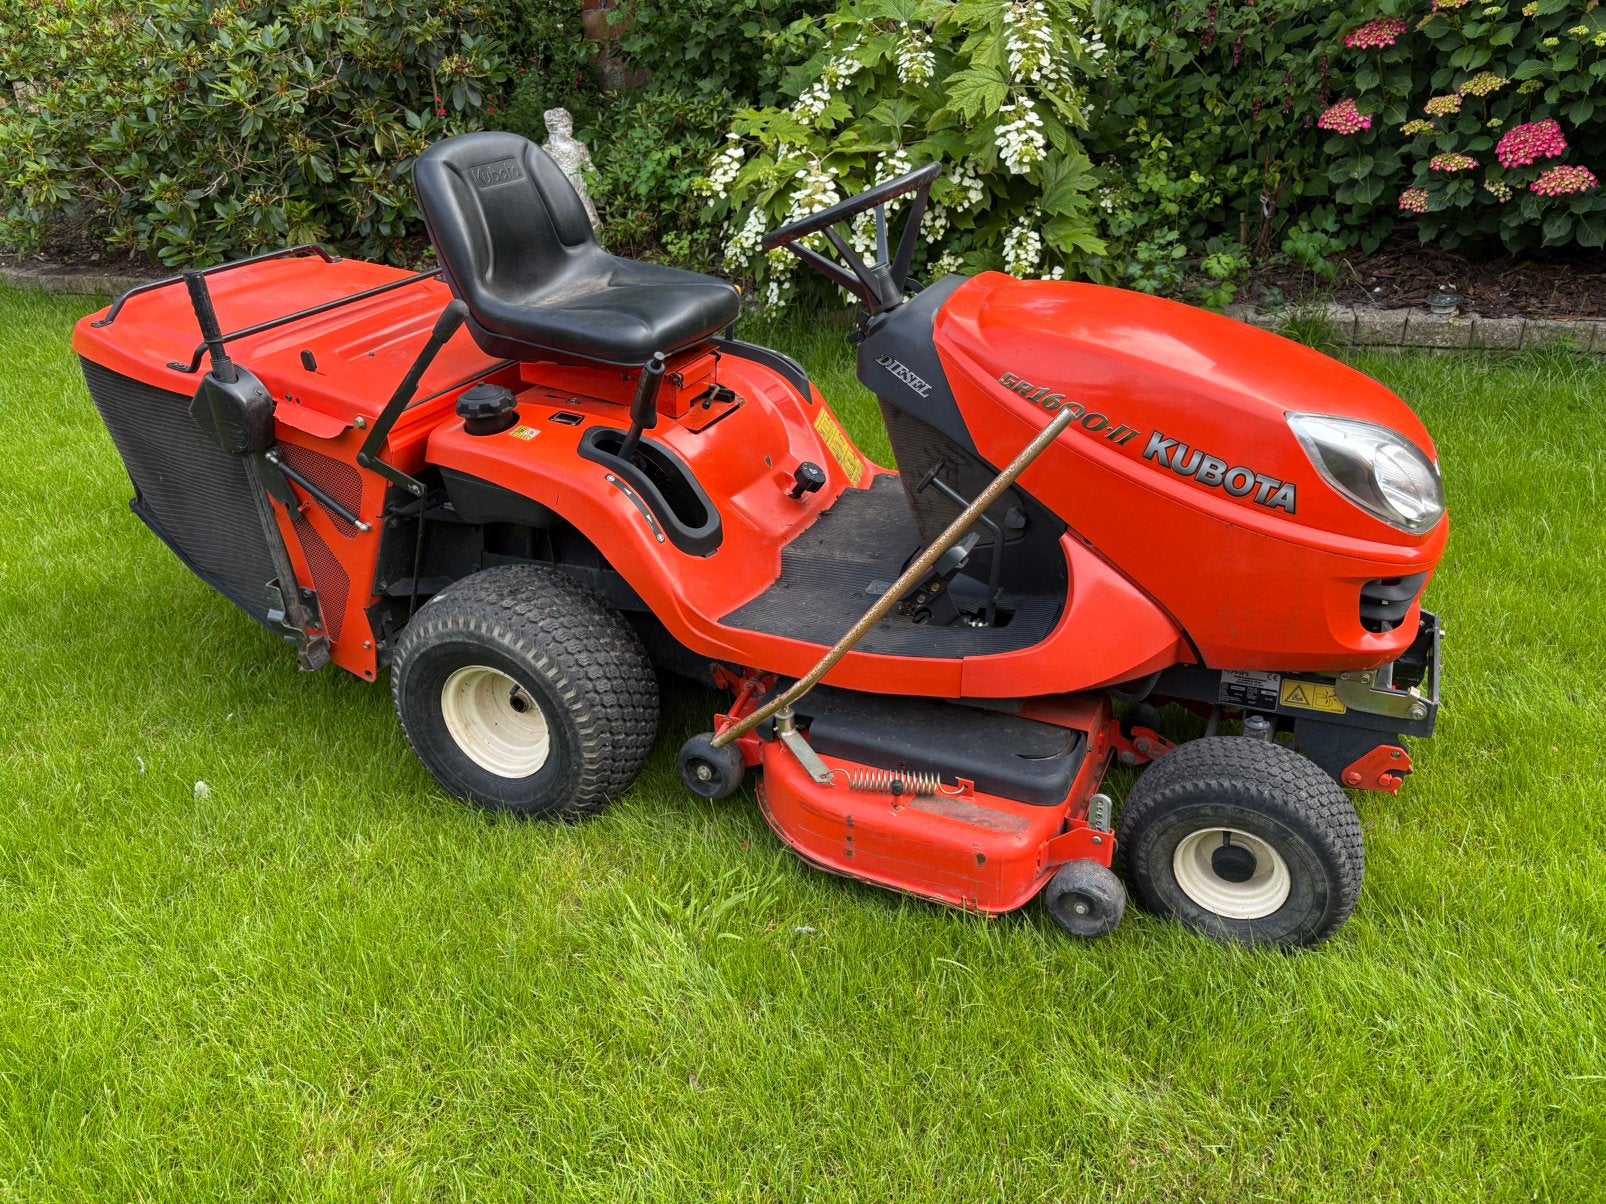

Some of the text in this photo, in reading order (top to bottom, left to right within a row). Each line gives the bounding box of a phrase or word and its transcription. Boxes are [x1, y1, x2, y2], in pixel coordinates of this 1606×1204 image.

[471, 160, 521, 186] Kubota
[874, 354, 933, 399] DIESEL
[1142, 429, 1297, 515] KUBOTA
